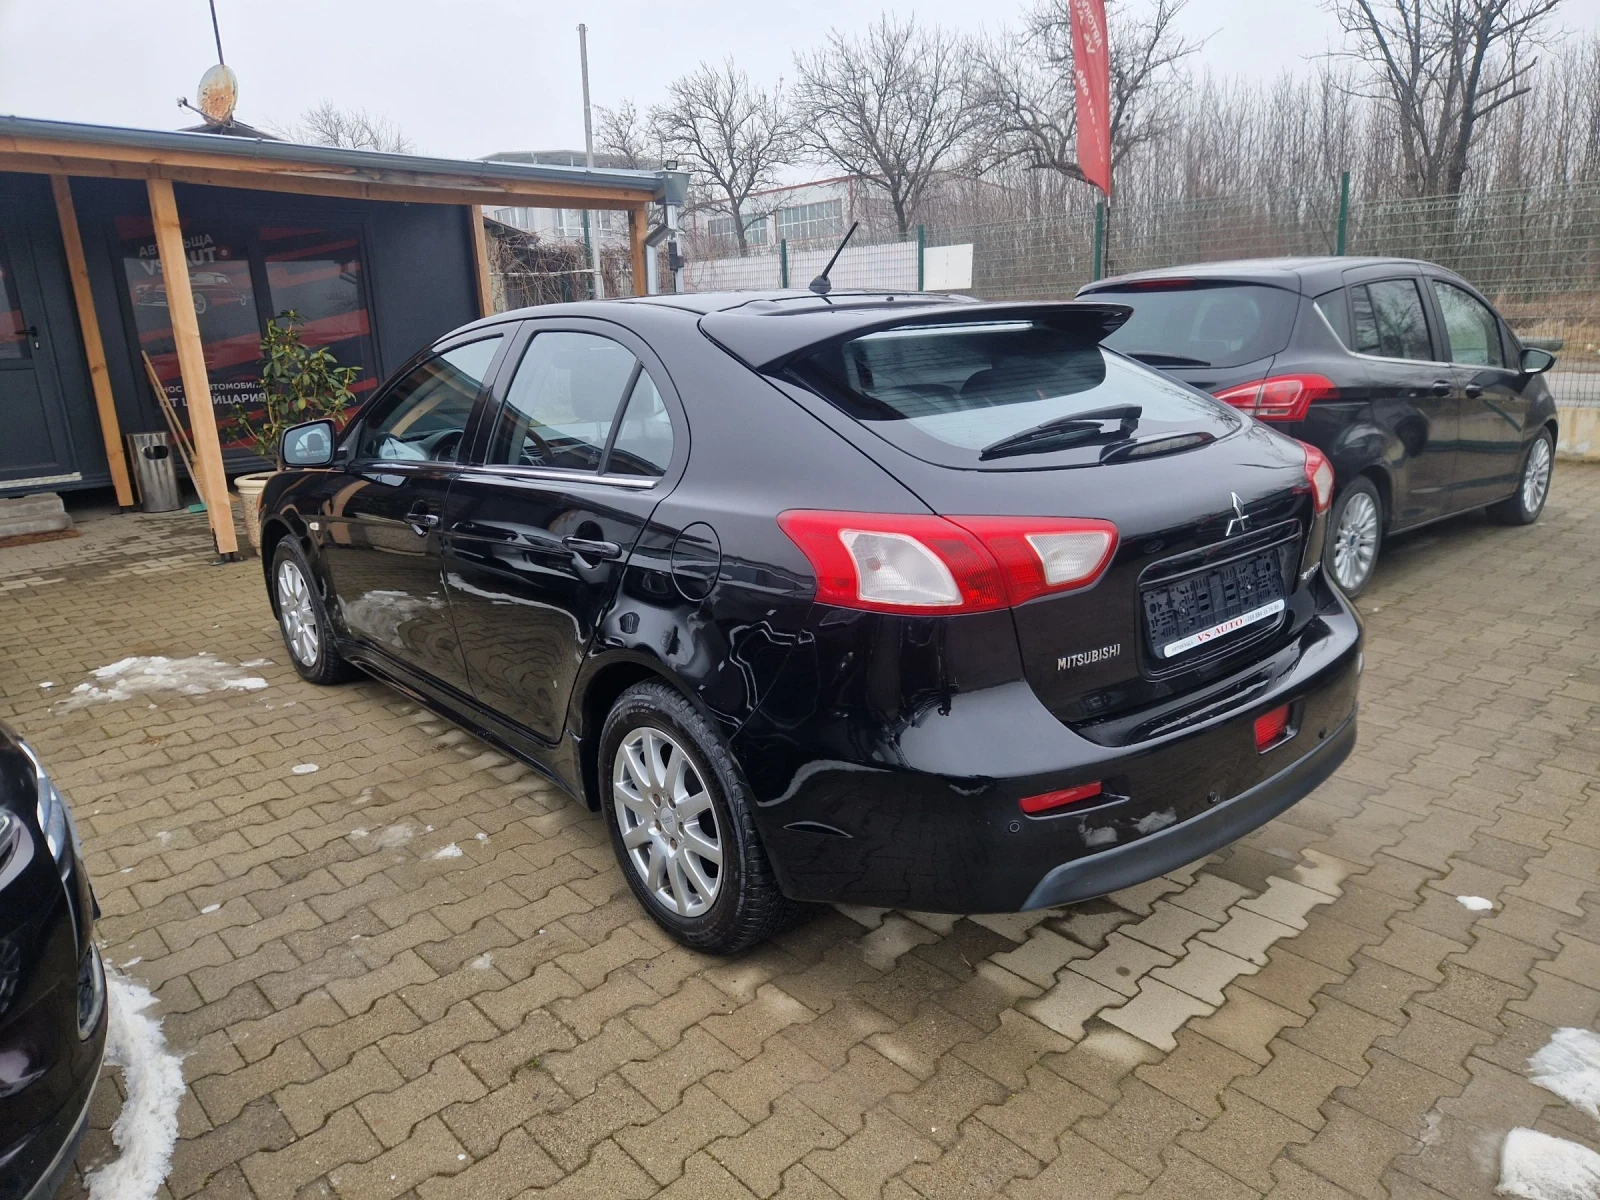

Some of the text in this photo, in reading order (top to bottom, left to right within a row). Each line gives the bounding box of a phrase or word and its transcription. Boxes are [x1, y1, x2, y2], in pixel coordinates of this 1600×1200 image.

[1197, 631, 1211, 642] VS
[1214, 619, 1243, 636] AUTO
[1057, 643, 1121, 671] MITSUBISHI
